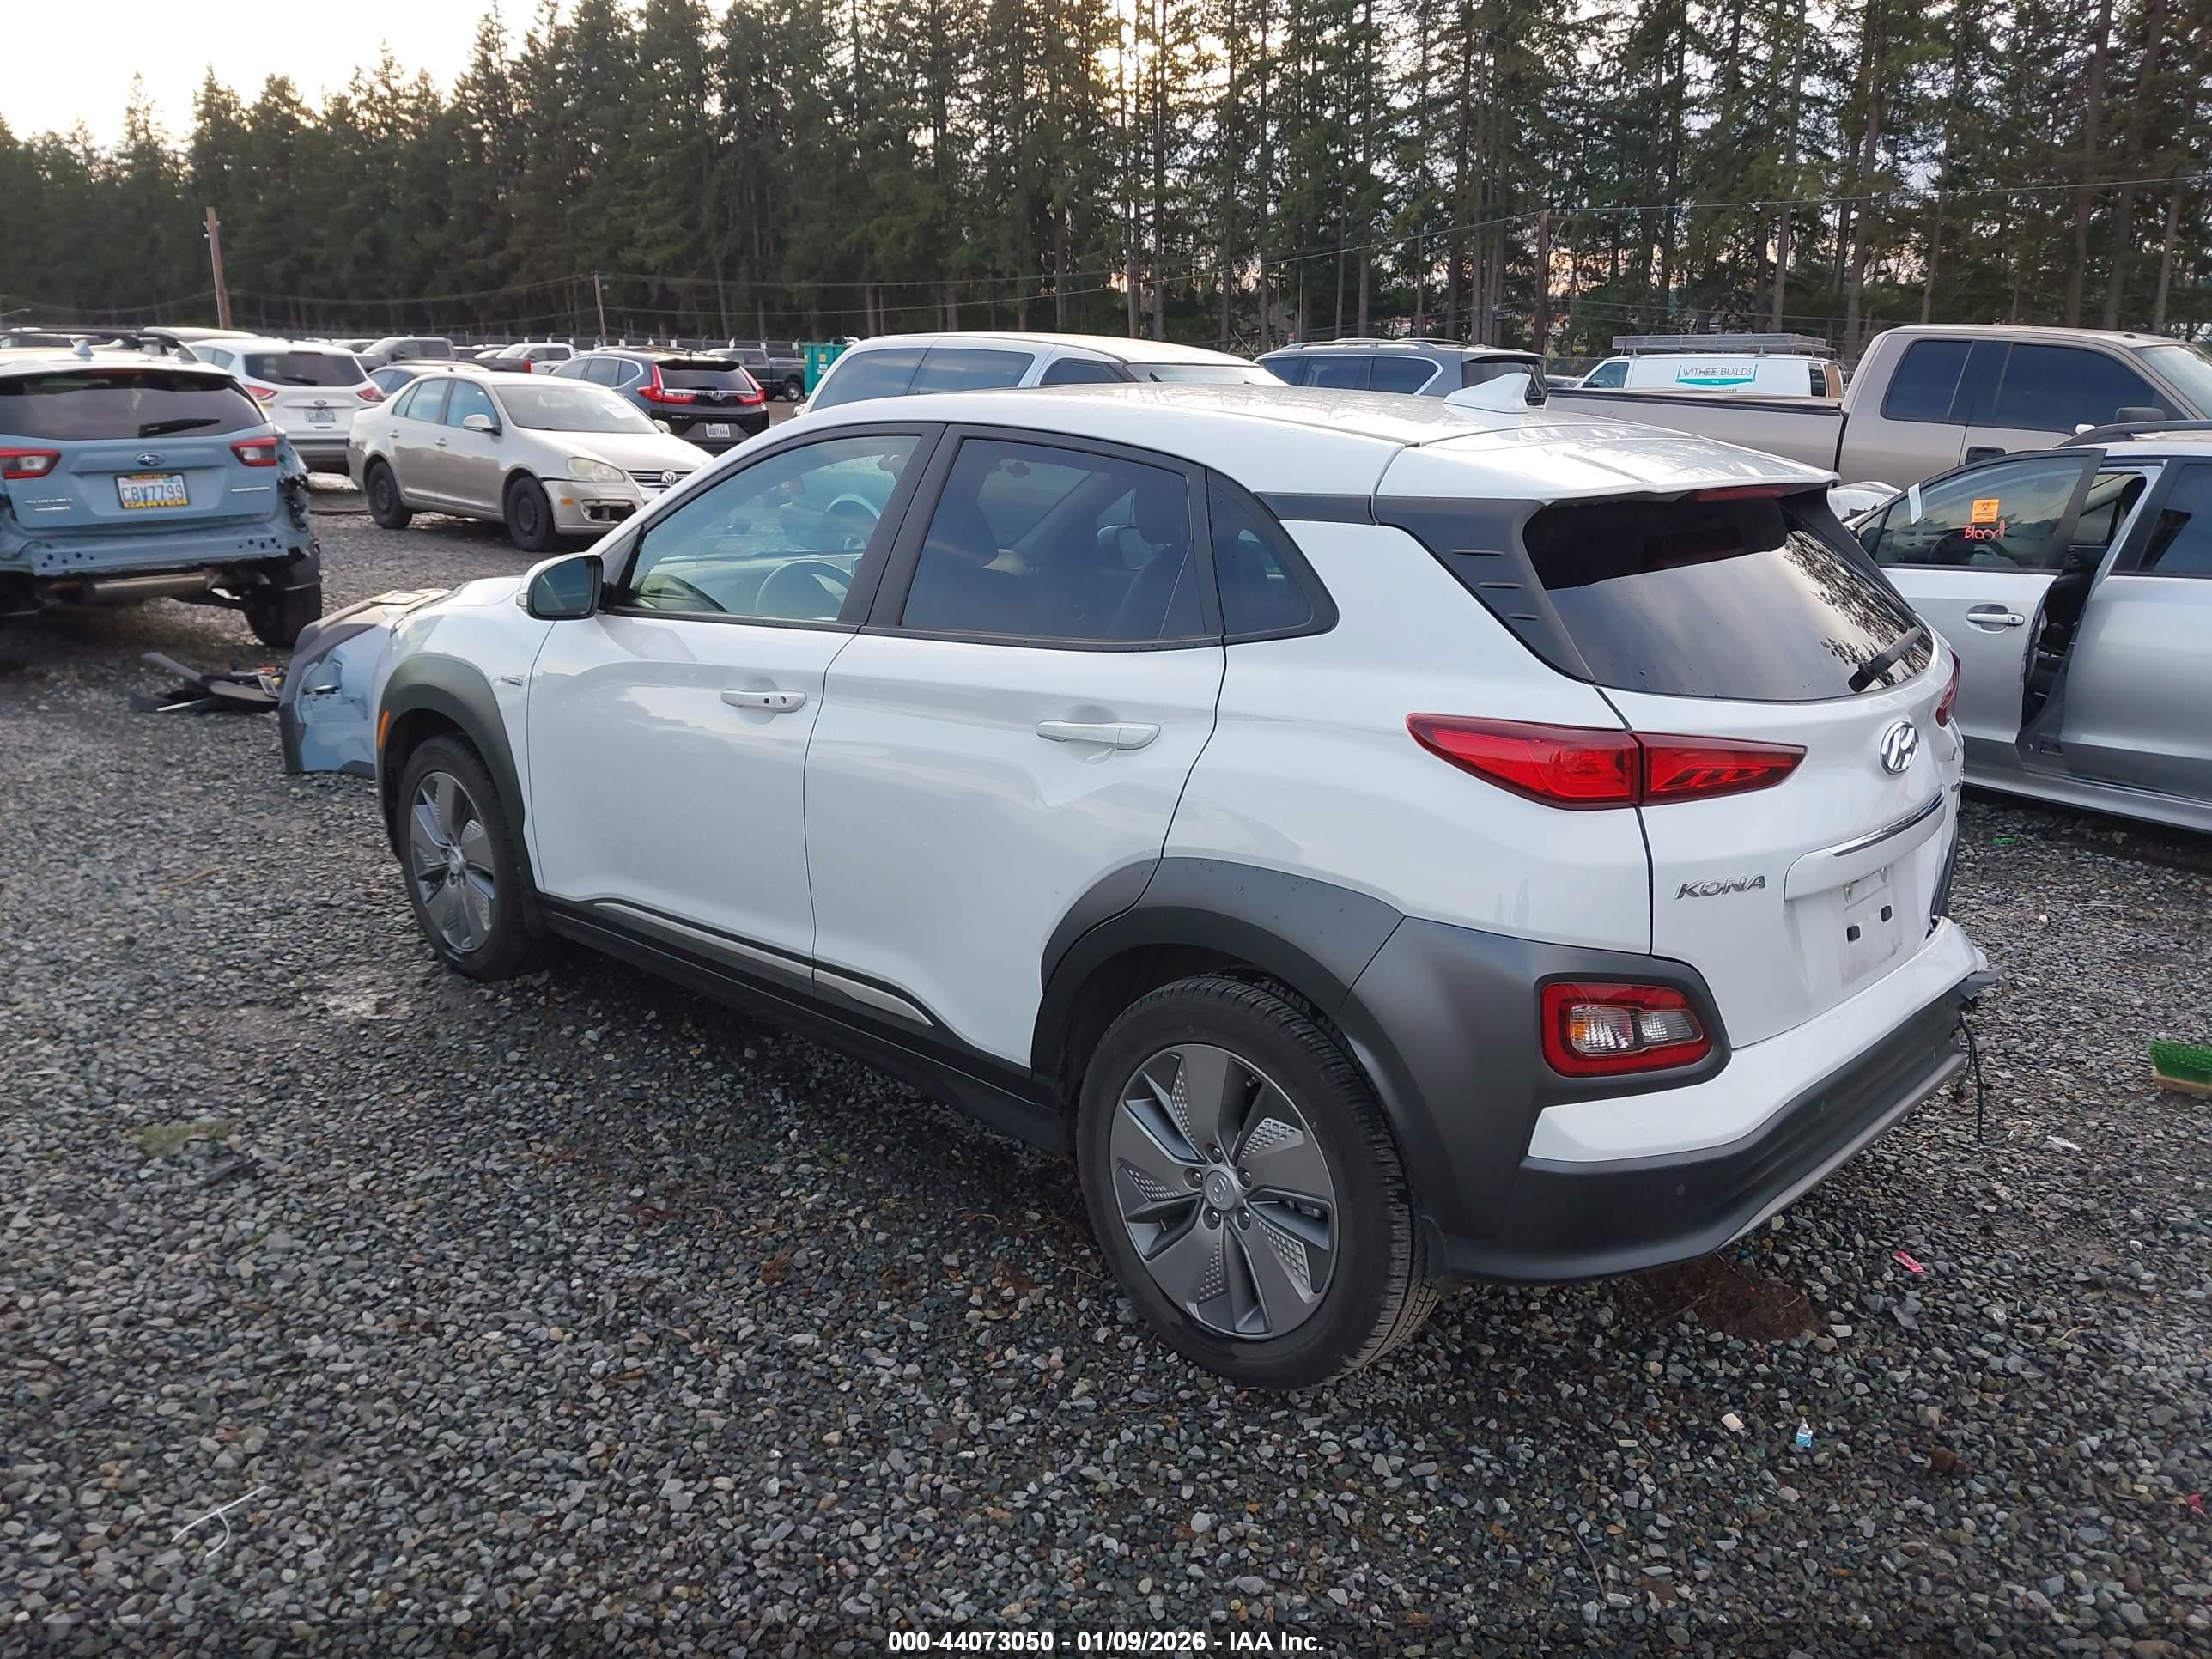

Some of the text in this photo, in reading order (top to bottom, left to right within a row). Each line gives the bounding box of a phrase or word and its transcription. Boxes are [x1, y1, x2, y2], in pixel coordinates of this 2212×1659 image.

[1683, 367, 1753, 376] WITHEE BUILDS
[1674, 873, 1765, 900] KONA
